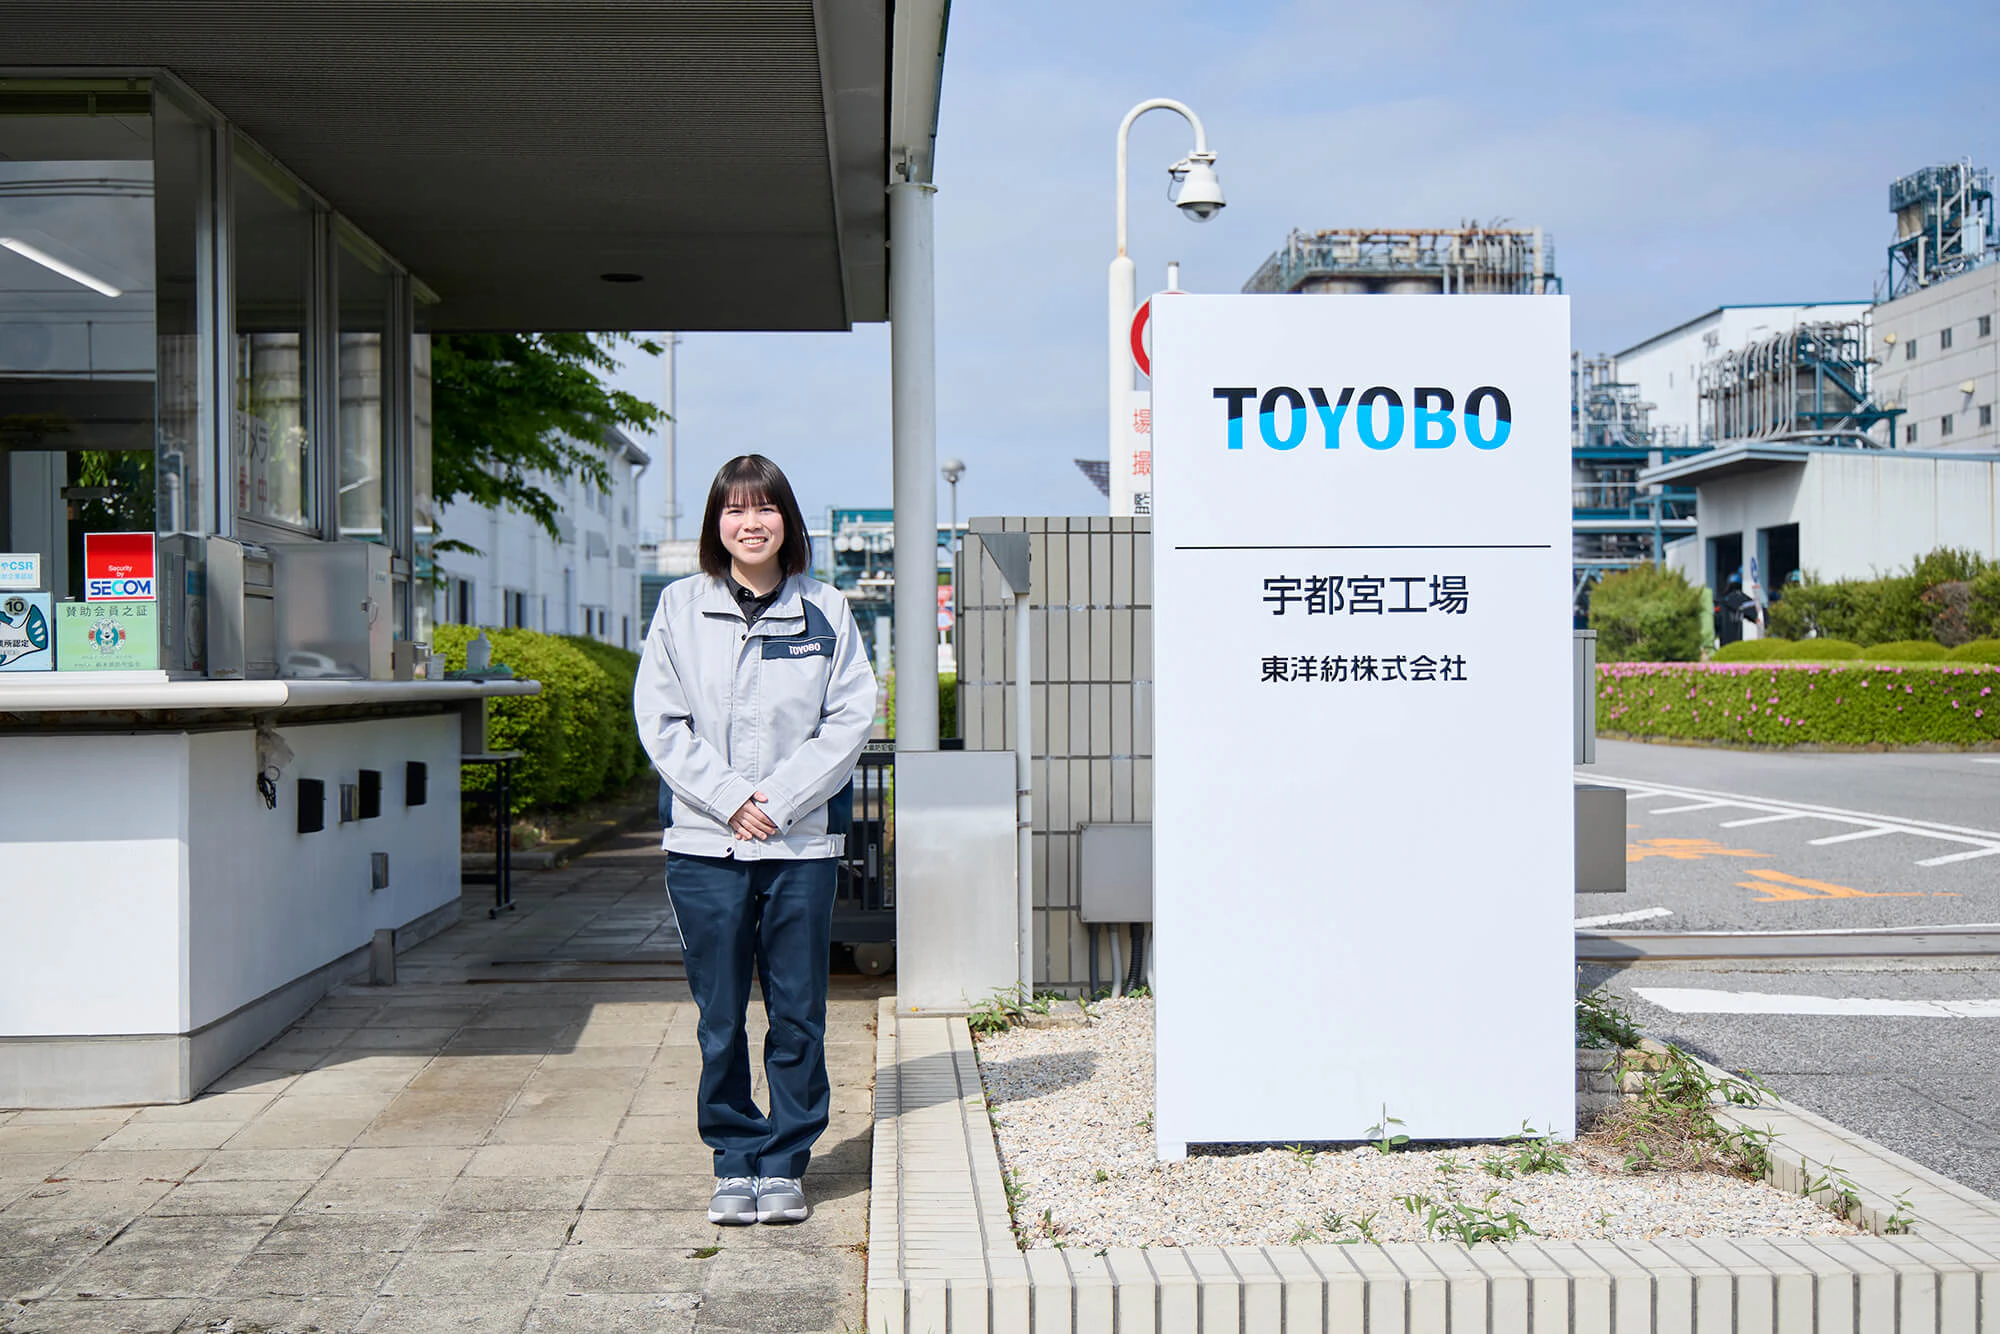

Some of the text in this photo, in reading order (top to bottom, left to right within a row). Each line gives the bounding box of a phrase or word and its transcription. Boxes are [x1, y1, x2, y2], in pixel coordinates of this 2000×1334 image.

[1212, 386, 1512, 450] TOYOBO
[108, 565, 132, 573] Security
[90, 580, 151, 596] SECOM
[1262, 575, 1469, 615] 宇都宮工場
[5, 601, 25, 613] 10
[788, 643, 821, 656] TOYOBO
[1261, 654, 1468, 682] 東洋紡株式会社
